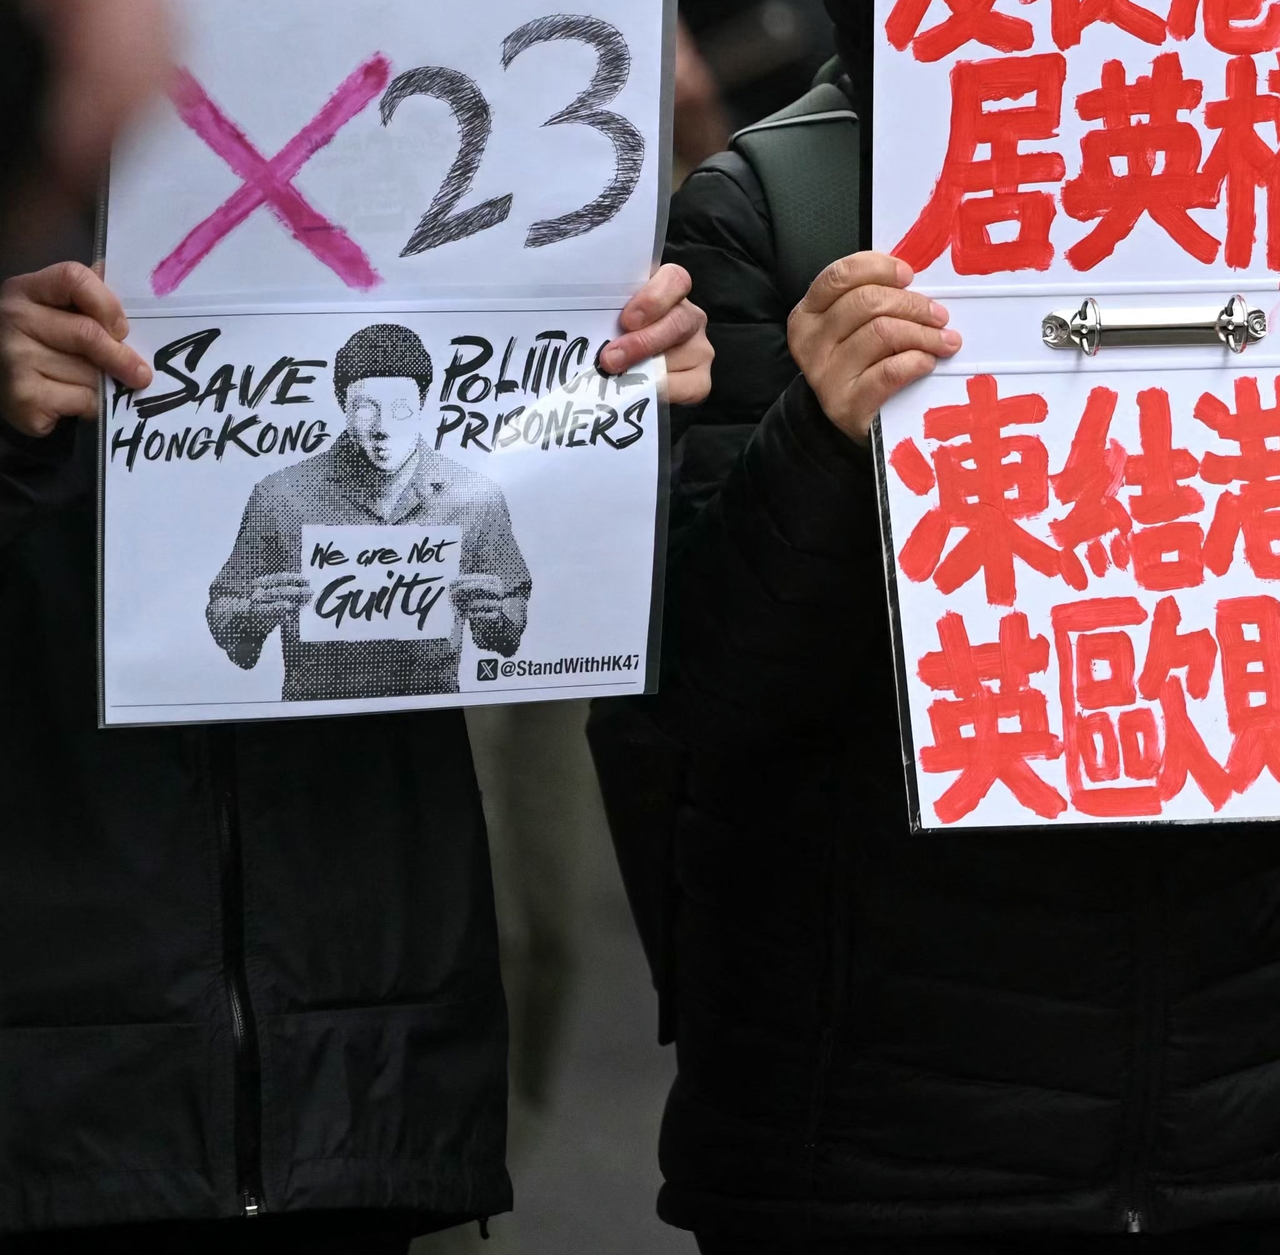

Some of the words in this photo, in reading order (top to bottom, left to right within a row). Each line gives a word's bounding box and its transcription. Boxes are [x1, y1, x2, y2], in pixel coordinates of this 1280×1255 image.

[133, 328, 328, 418] SAVE
[111, 414, 332, 472] HONGKONG
[435, 397, 650, 453] PRISONERS
[311, 541, 349, 570] We
[356, 547, 403, 566] are
[407, 537, 458, 565] Not
[314, 570, 446, 631] Guilty
